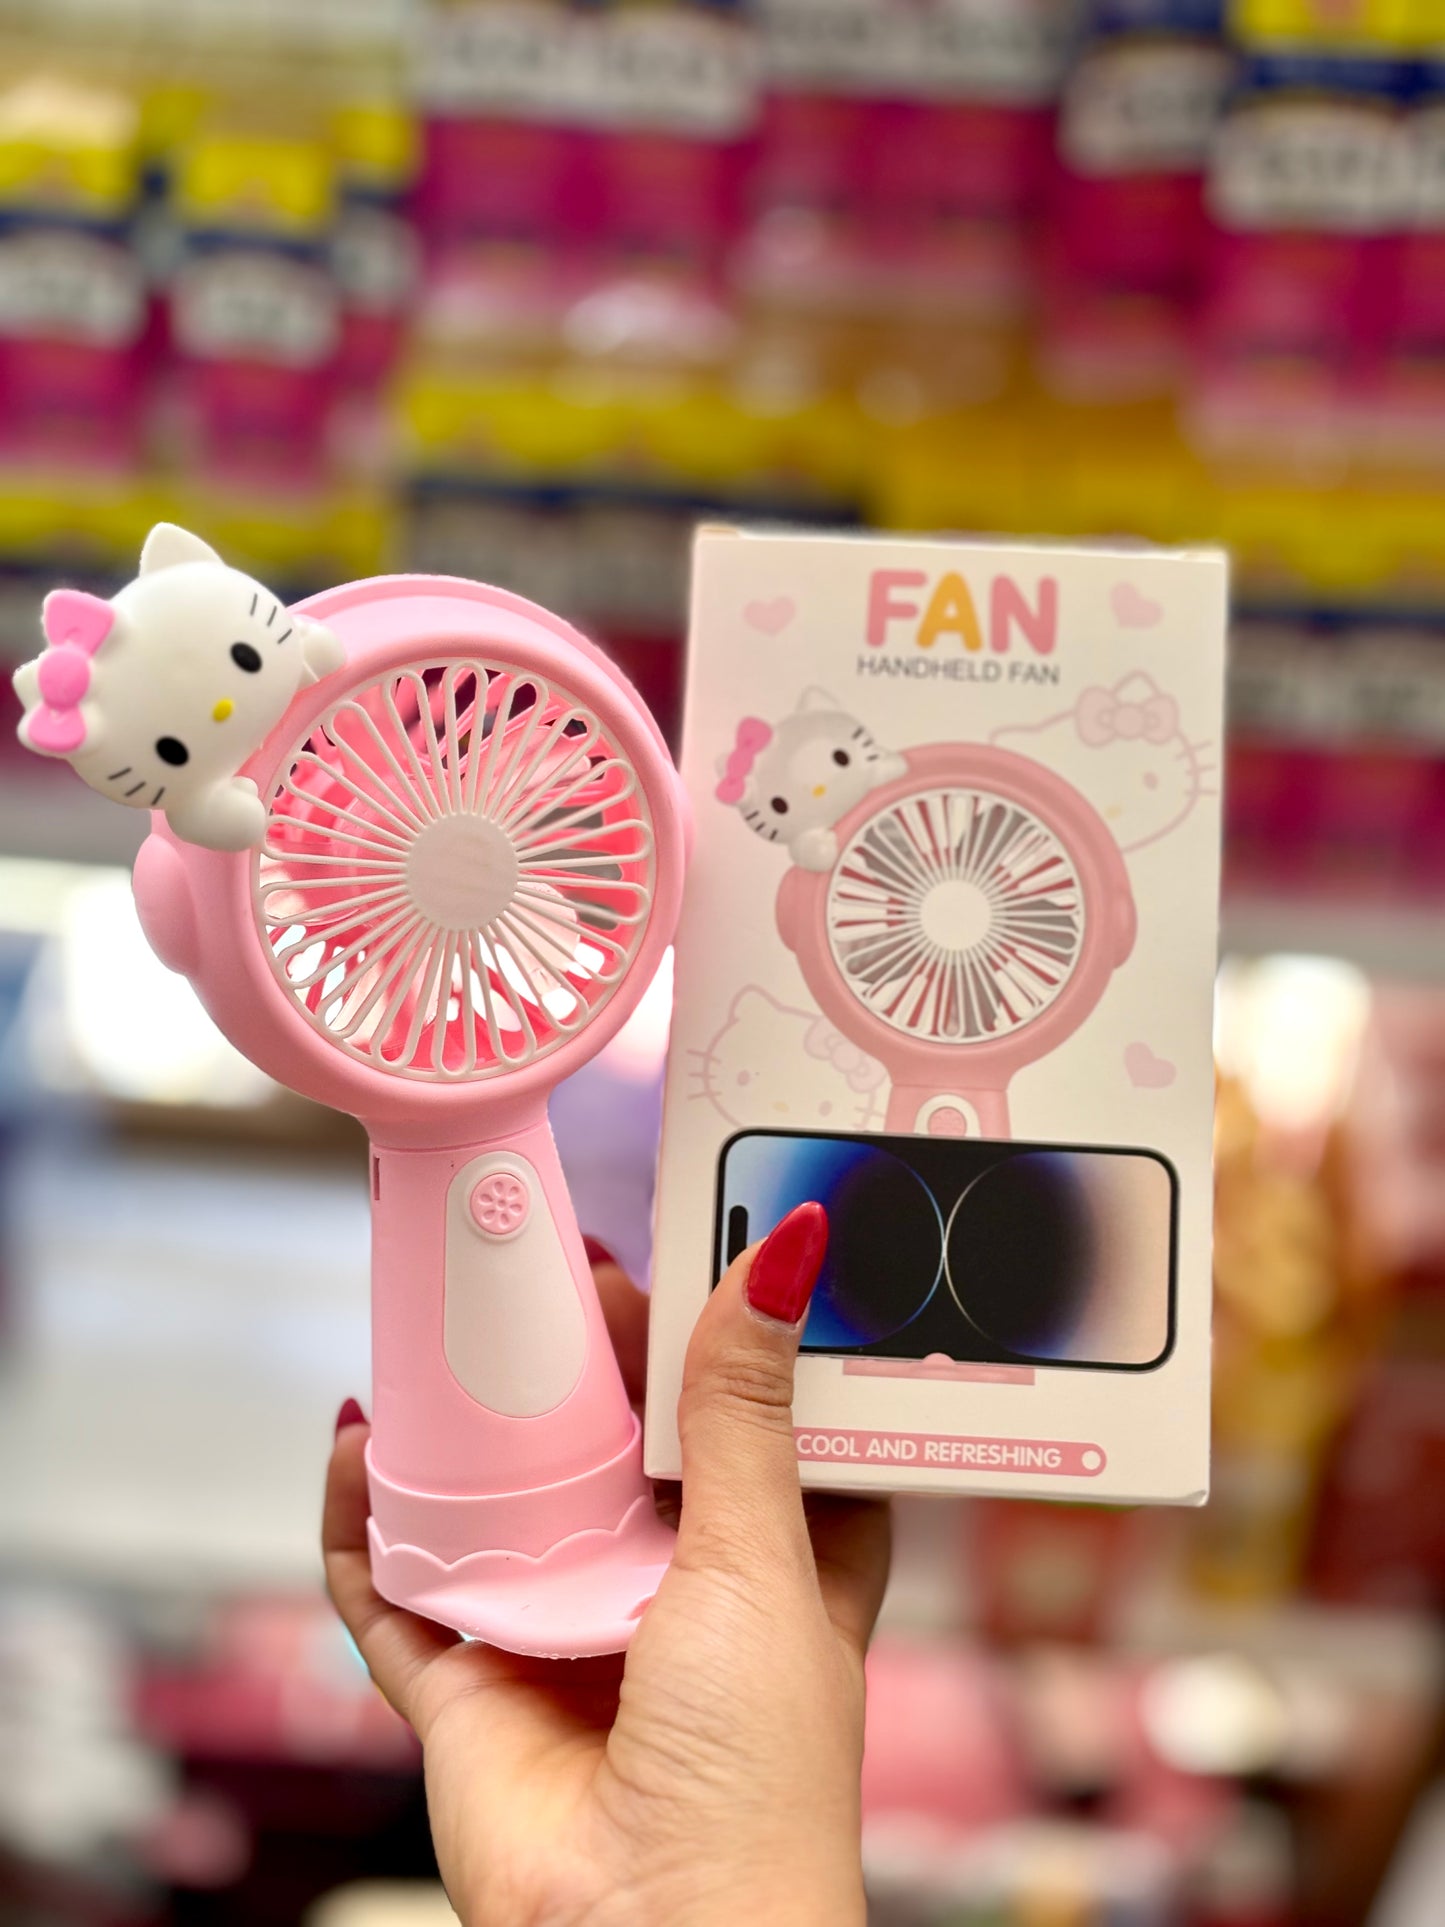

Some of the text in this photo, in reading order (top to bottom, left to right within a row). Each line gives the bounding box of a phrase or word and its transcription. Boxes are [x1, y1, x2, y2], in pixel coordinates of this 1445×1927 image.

[866, 570, 1057, 654] FAN
[858, 657, 1061, 686] HANDHELD FAN
[796, 1434, 1062, 1468] COOL AND REFRESHING
